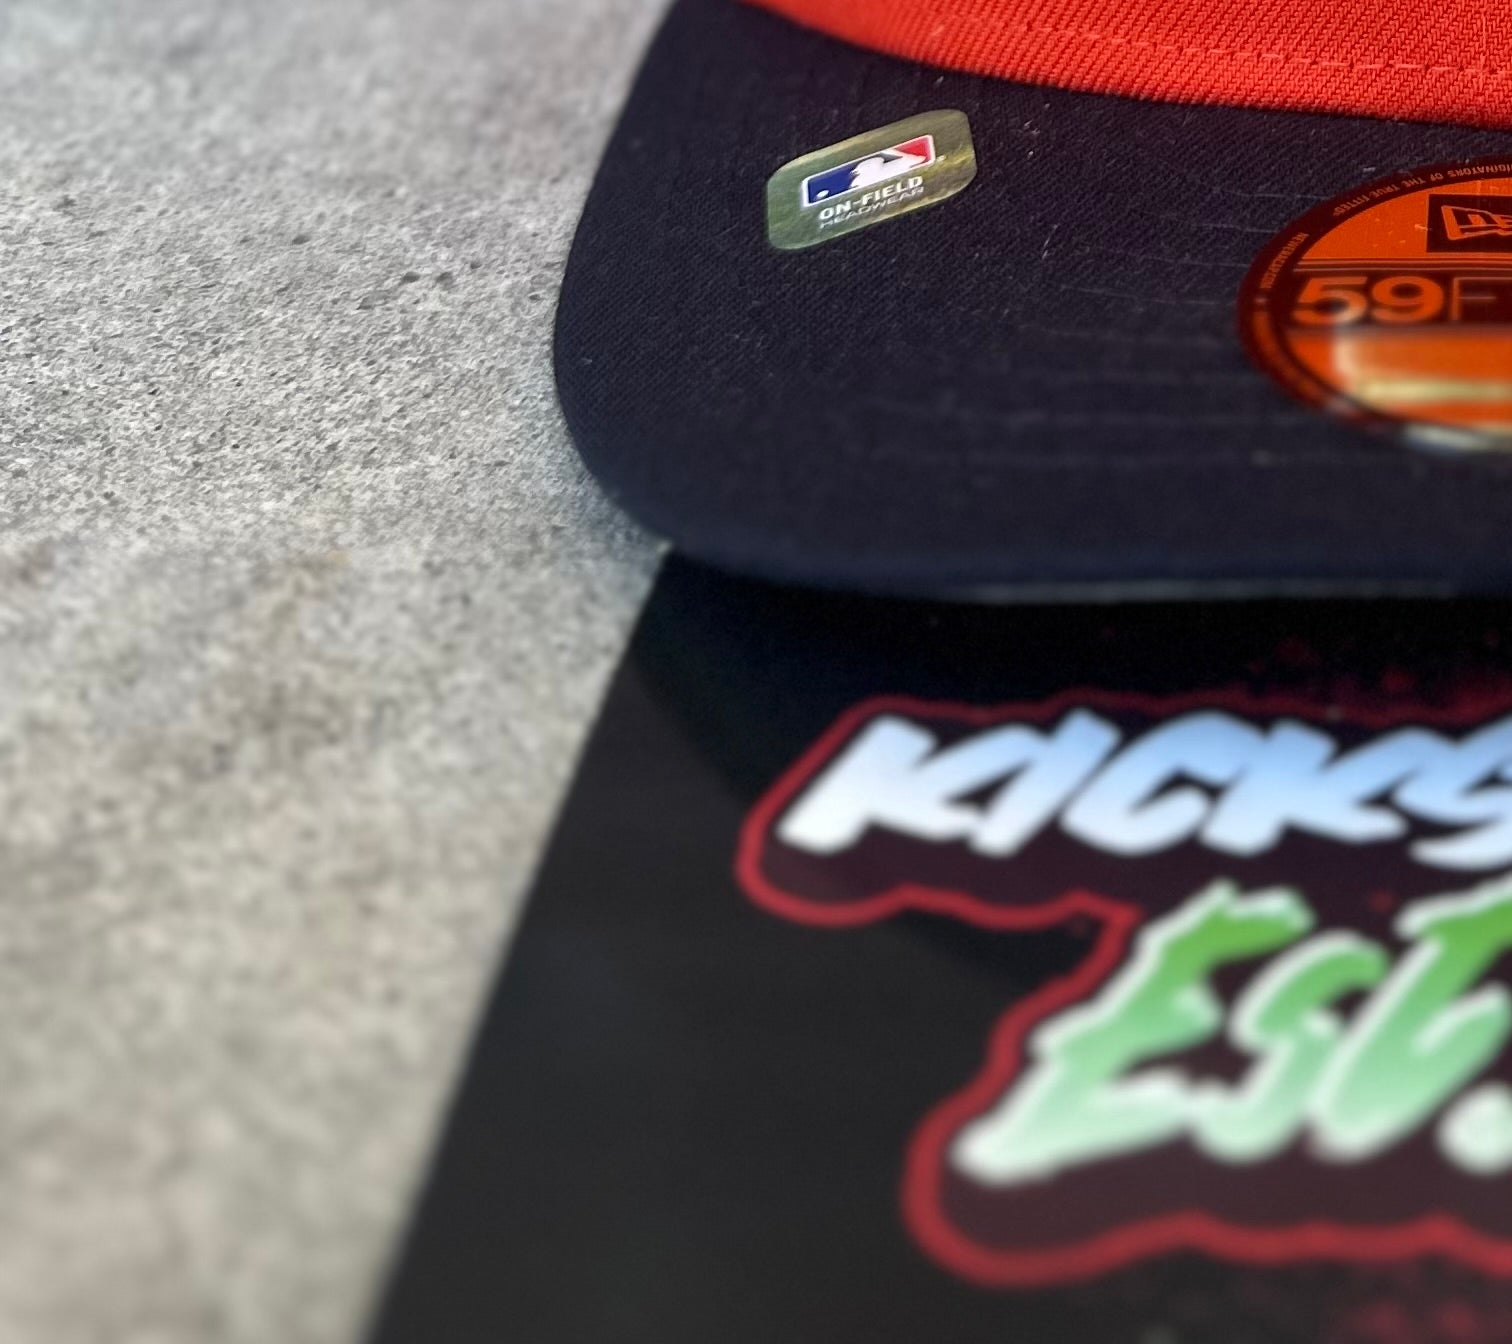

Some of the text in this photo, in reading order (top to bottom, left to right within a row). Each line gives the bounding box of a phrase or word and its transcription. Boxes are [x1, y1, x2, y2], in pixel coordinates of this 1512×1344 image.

[818, 175, 924, 220] ON-FIELD
[1401, 177, 1427, 188] THE
[819, 185, 925, 230] HEADWEAR
